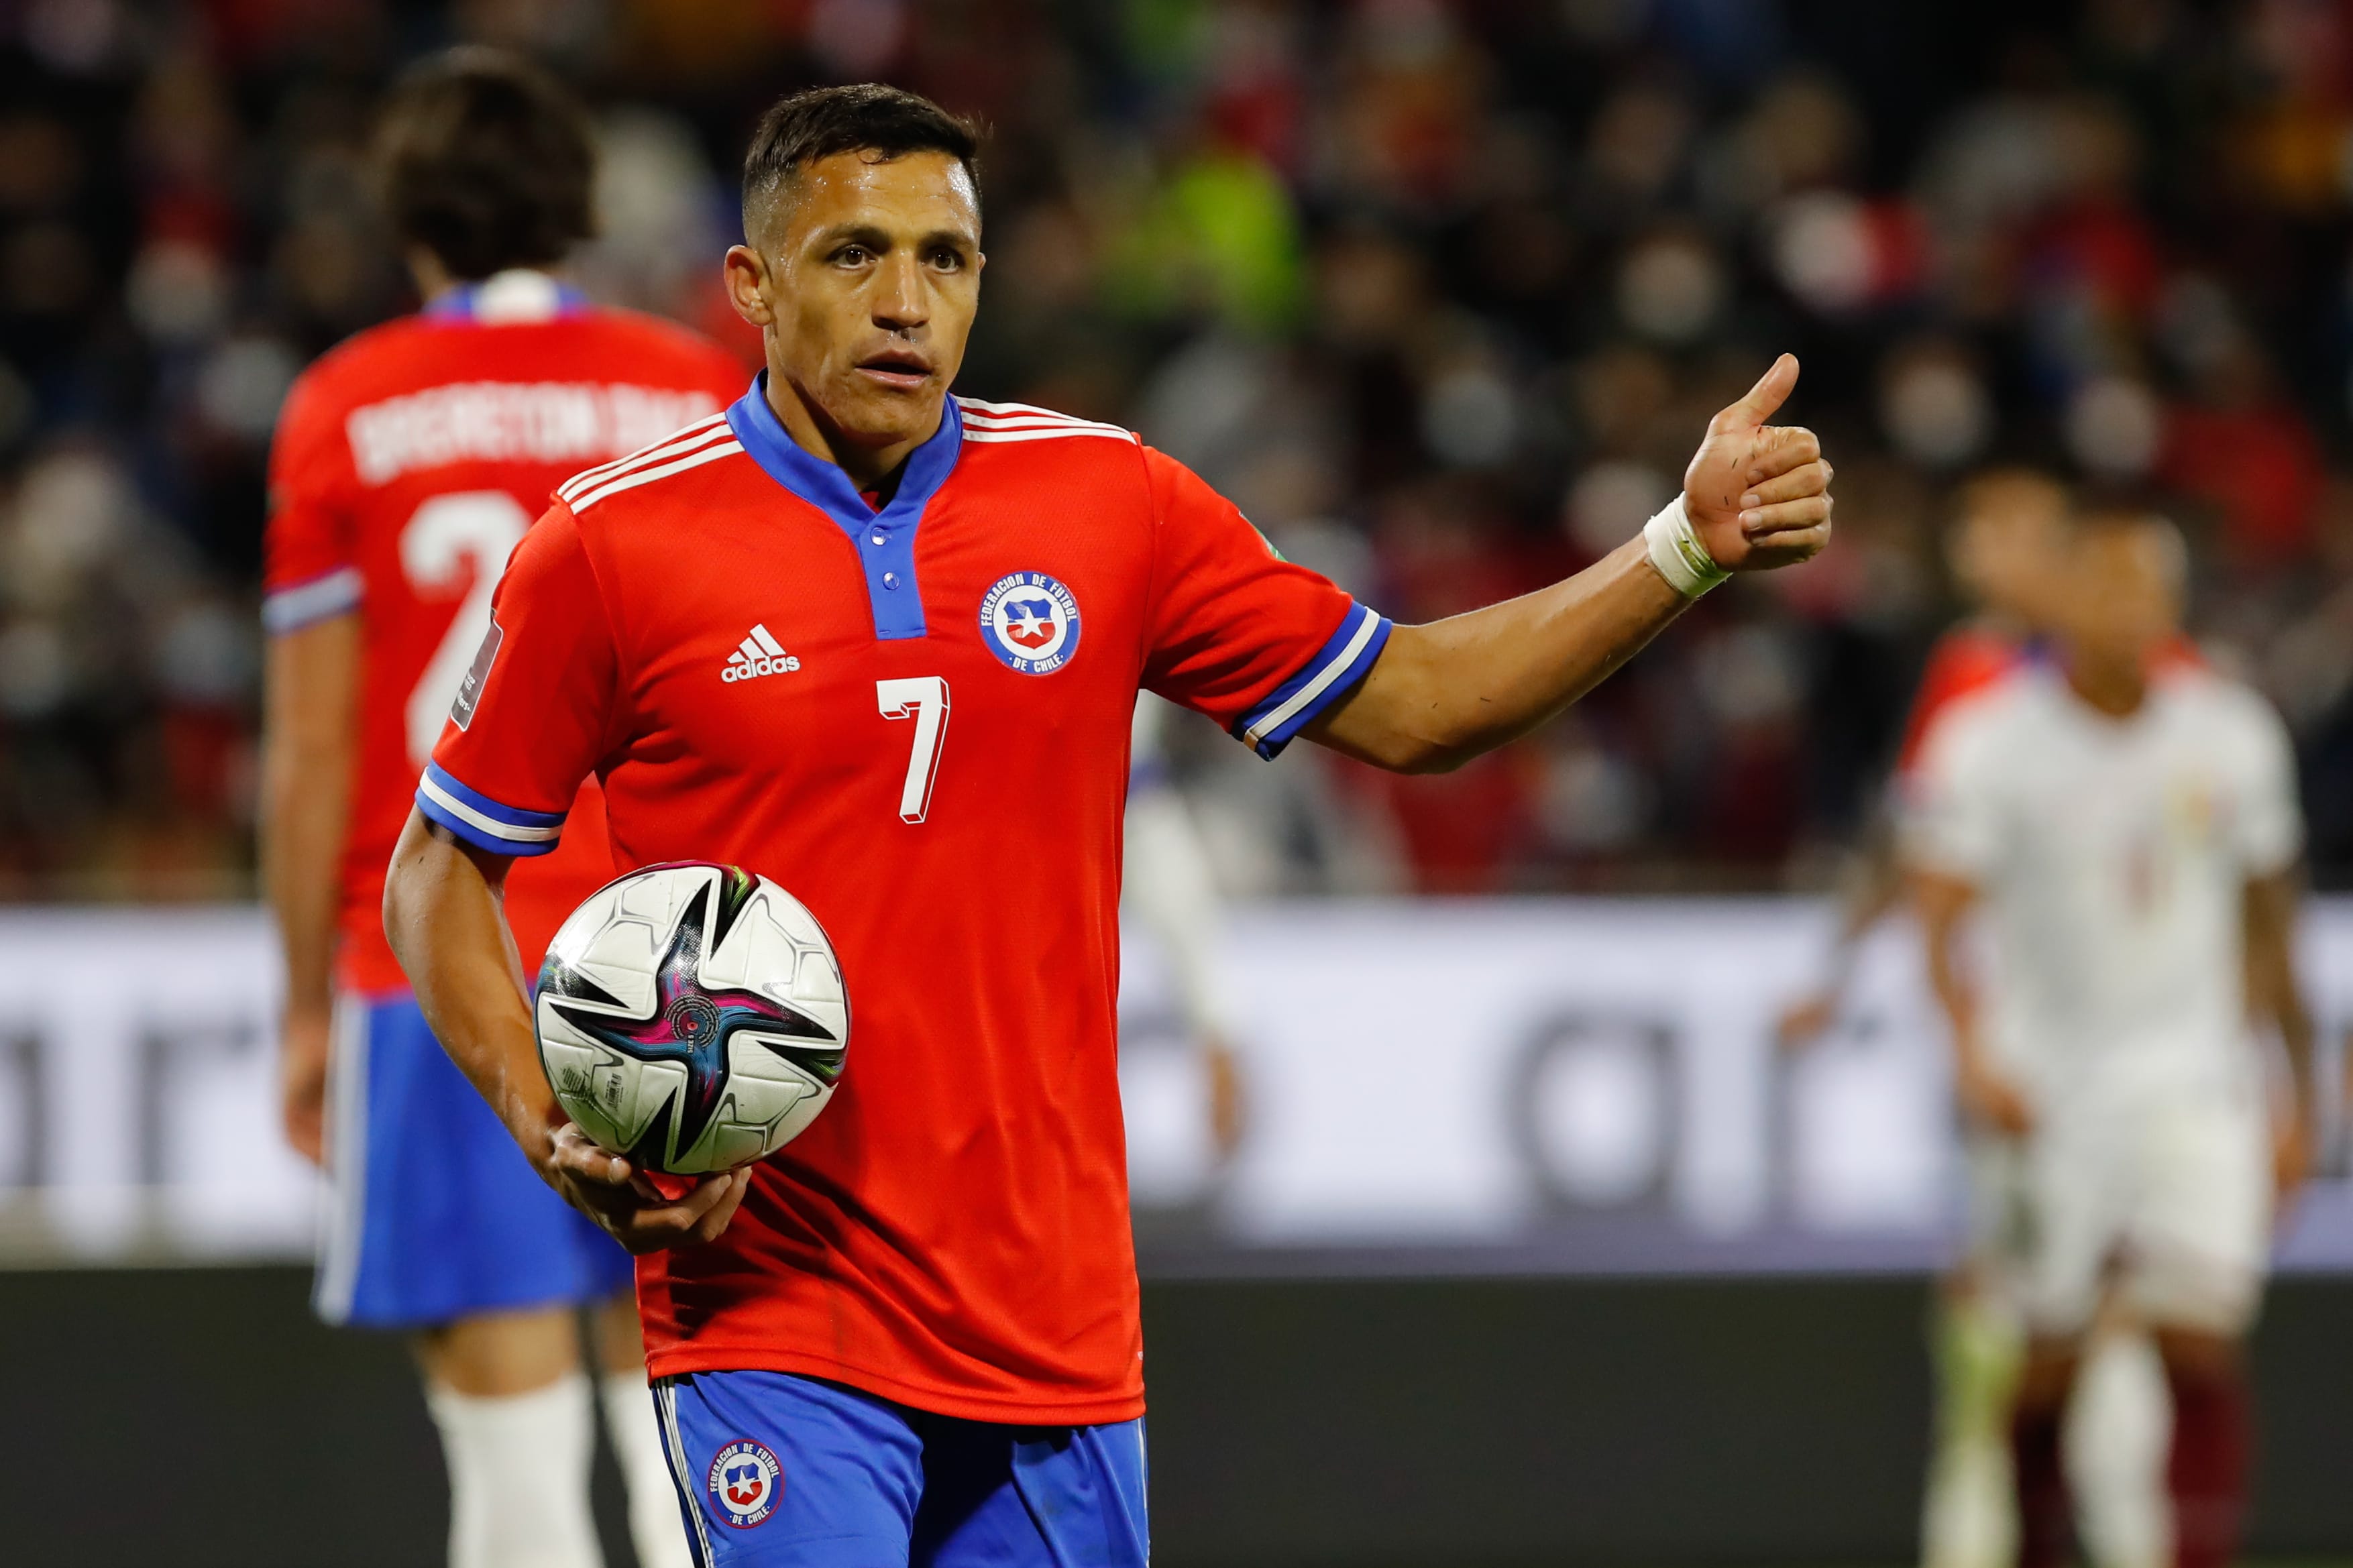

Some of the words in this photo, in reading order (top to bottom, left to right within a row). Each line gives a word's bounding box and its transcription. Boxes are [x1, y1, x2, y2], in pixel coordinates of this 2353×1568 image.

[981, 573, 1025, 626] FEDERACION
[1032, 573, 1046, 587] DE
[1049, 582, 1077, 622] FUTBOL
[721, 655, 801, 683] adidas
[1013, 658, 1027, 671] DE
[1034, 654, 1062, 673] CHILE
[876, 675, 950, 824] 7
[687, 1040, 695, 1054] SIZE
[710, 1444, 738, 1492] FEDERACION
[743, 1443, 754, 1453] DE
[756, 1448, 779, 1478] FUTBOL
[732, 1514, 743, 1525] DE
[747, 1506, 769, 1524] CHILE
